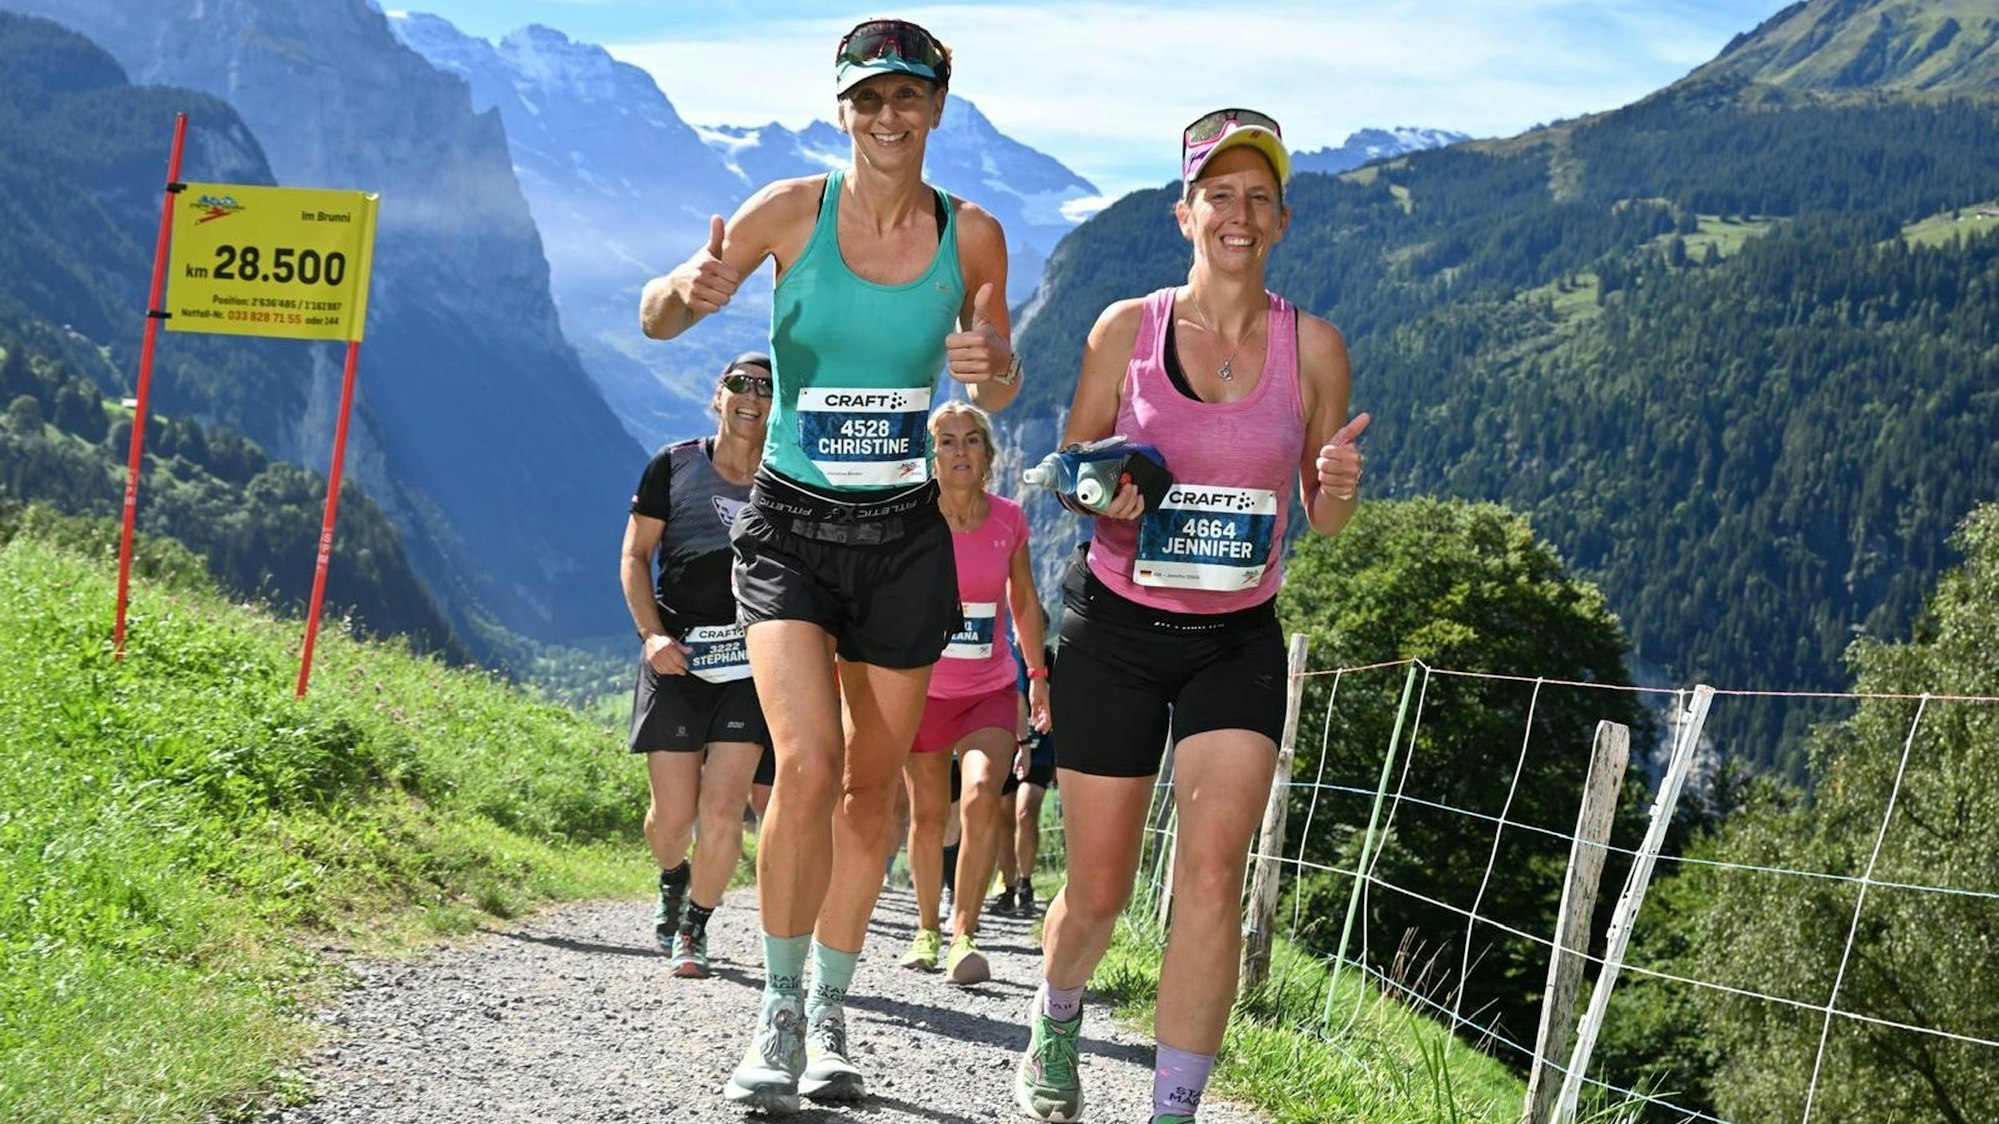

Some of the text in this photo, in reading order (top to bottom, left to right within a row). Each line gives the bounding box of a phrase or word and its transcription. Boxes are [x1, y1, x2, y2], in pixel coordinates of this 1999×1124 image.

[301, 210, 351, 223] Im Brunni
[185, 244, 346, 286] km 28.500
[227, 310, 248, 322] 033
[250, 311, 270, 323] 828
[273, 312, 285, 323] 71
[287, 313, 302, 325] 55
[305, 316, 324, 325] oder
[825, 395, 889, 407] CRAFT
[840, 419, 890, 438] 4528
[818, 438, 910, 455] CHRISTINE
[1168, 490, 1237, 507] CRAFT
[1182, 518, 1237, 540] 4664
[1161, 537, 1254, 559] JENNIFER
[698, 628, 738, 639] CRAFT
[709, 642, 740, 654] 3222
